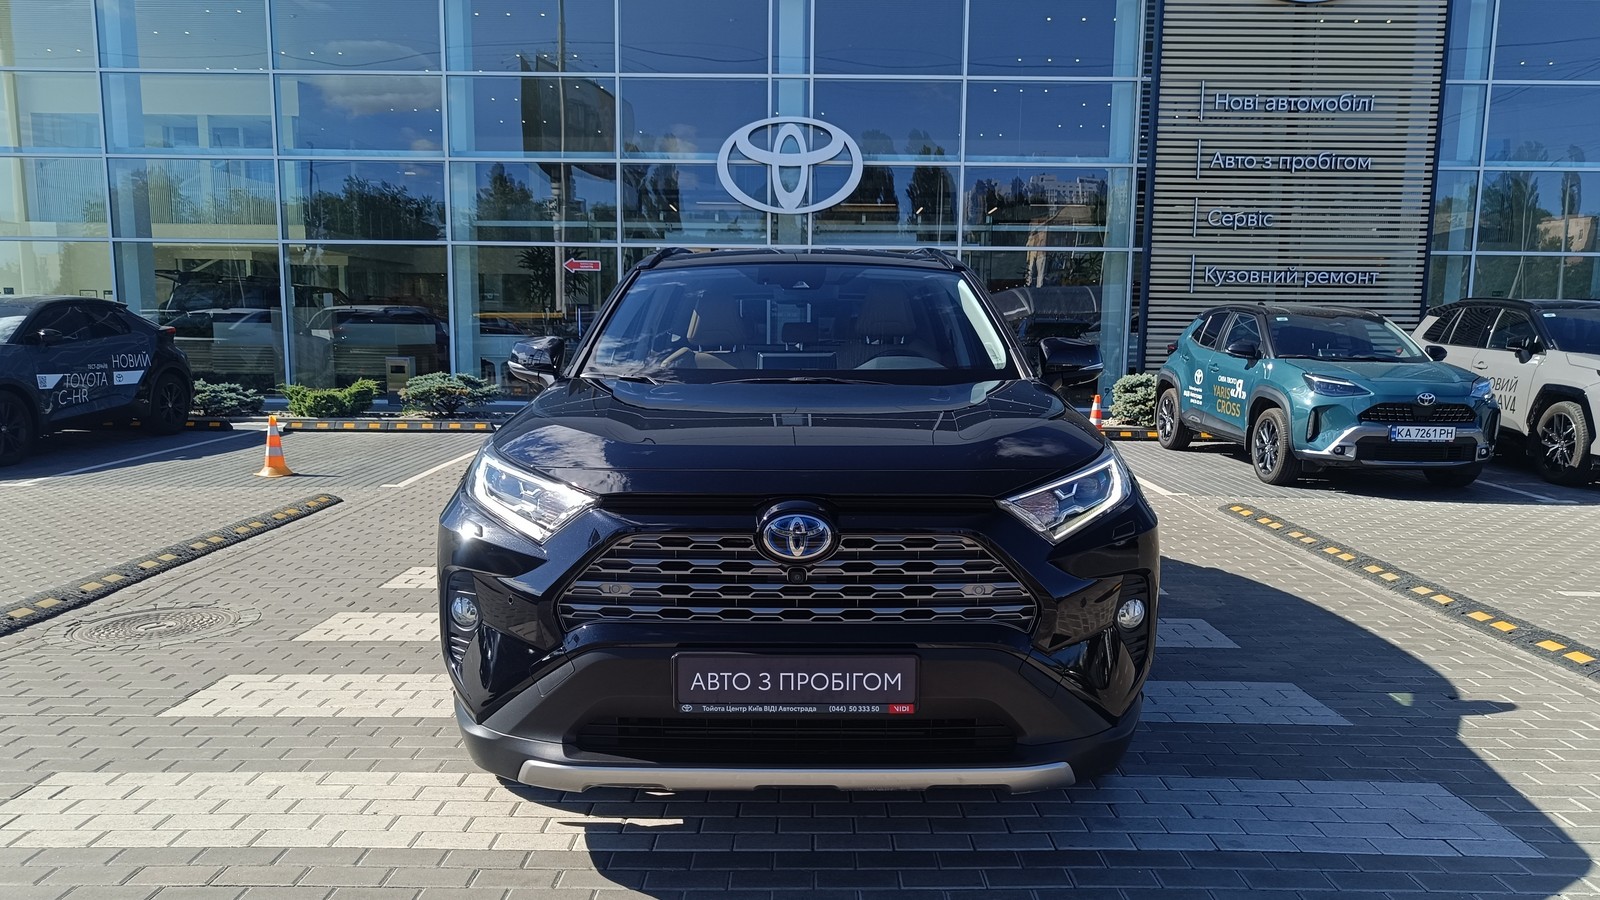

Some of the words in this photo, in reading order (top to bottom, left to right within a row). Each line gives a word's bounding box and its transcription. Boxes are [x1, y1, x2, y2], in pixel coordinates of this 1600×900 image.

[1215, 93, 1259, 111] Нові
[1265, 93, 1376, 112] автомобілі
[1210, 151, 1256, 169] Авто
[1261, 155, 1272, 169] з
[1279, 151, 1372, 173] пробігом
[1207, 209, 1274, 231] Сервіс
[1204, 266, 1299, 287] Кузовний
[1304, 271, 1380, 288] ремонт
[111, 351, 152, 369] НОВИЙ
[63, 372, 109, 388] TOYOTA
[1488, 376, 1519, 393] ОВИЙ
[58, 389, 89, 405] C-HR
[1213, 384, 1231, 400] YARIS
[1216, 399, 1241, 417] CROSS
[1491, 393, 1516, 414] AV4
[1397, 428, 1412, 438] KA
[1414, 428, 1437, 438] 7261
[1438, 428, 1454, 439] PH
[690, 672, 751, 691] АВТО
[758, 672, 772, 691] З
[779, 672, 902, 691] ПРОБІГОМ
[726, 705, 747, 713] Центр
[763, 705, 777, 713] ВІДІ
[778, 705, 817, 713] Автострада
[828, 705, 847, 713] (044)
